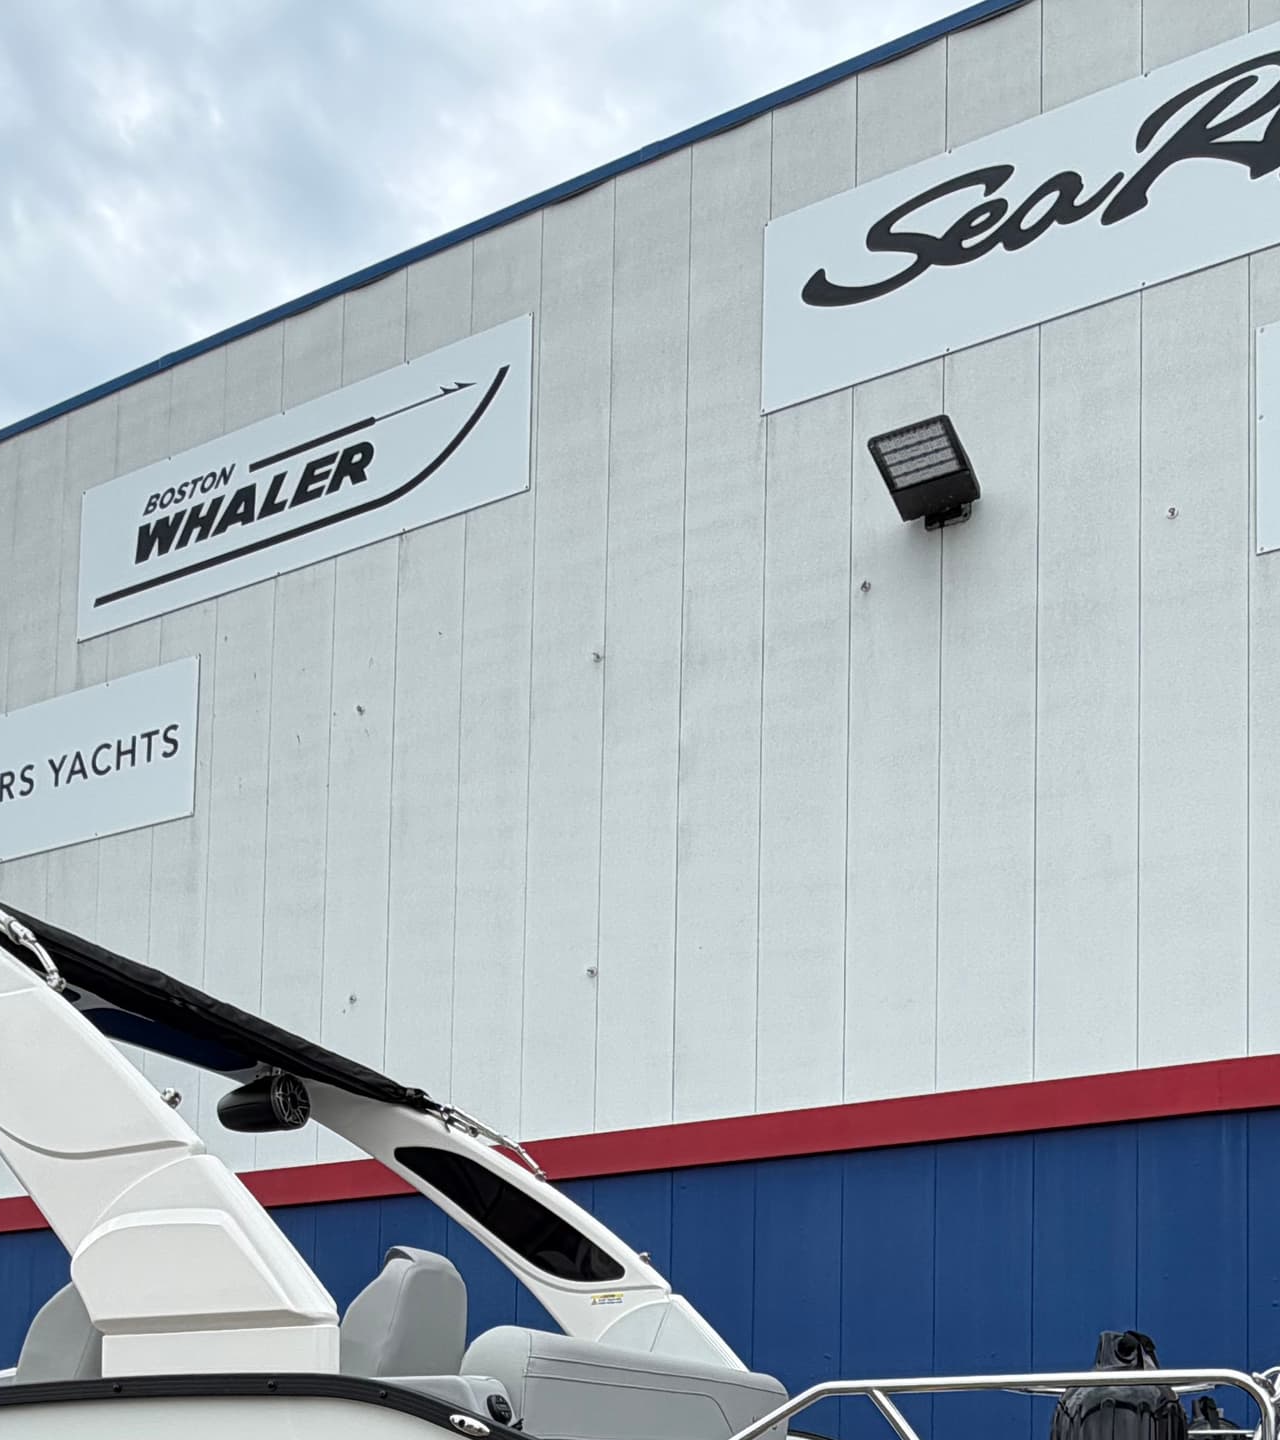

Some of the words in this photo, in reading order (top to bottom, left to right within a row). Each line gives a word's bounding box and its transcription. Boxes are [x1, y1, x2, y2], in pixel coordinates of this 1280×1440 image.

[801, 164, 1125, 307] Sea
[134, 441, 375, 565] WHALER
[143, 463, 236, 516] BOSTON
[47, 724, 179, 787] YACHTS
